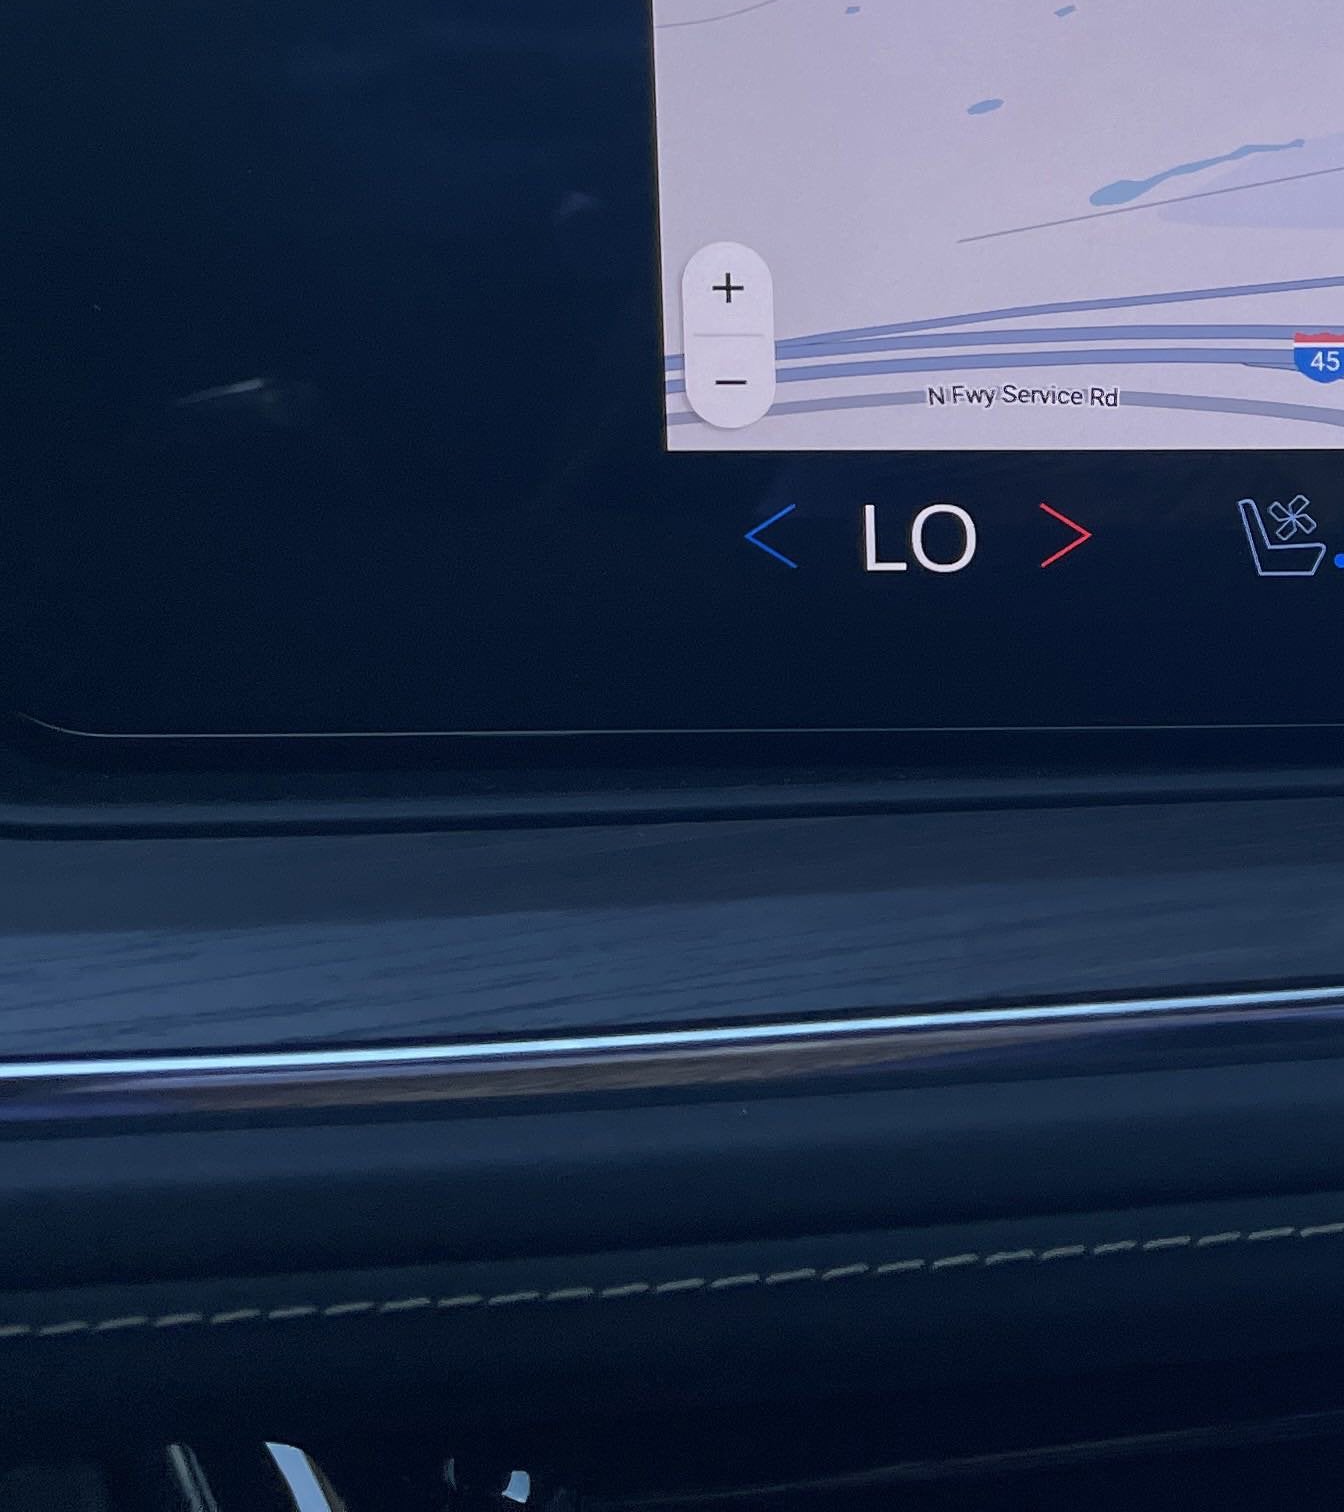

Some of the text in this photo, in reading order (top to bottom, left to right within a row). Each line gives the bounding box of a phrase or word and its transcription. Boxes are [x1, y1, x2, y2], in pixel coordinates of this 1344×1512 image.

[1310, 351, 1341, 374] 45
[927, 385, 1119, 410] N Fwy Service Rd
[863, 503, 978, 573] LO
